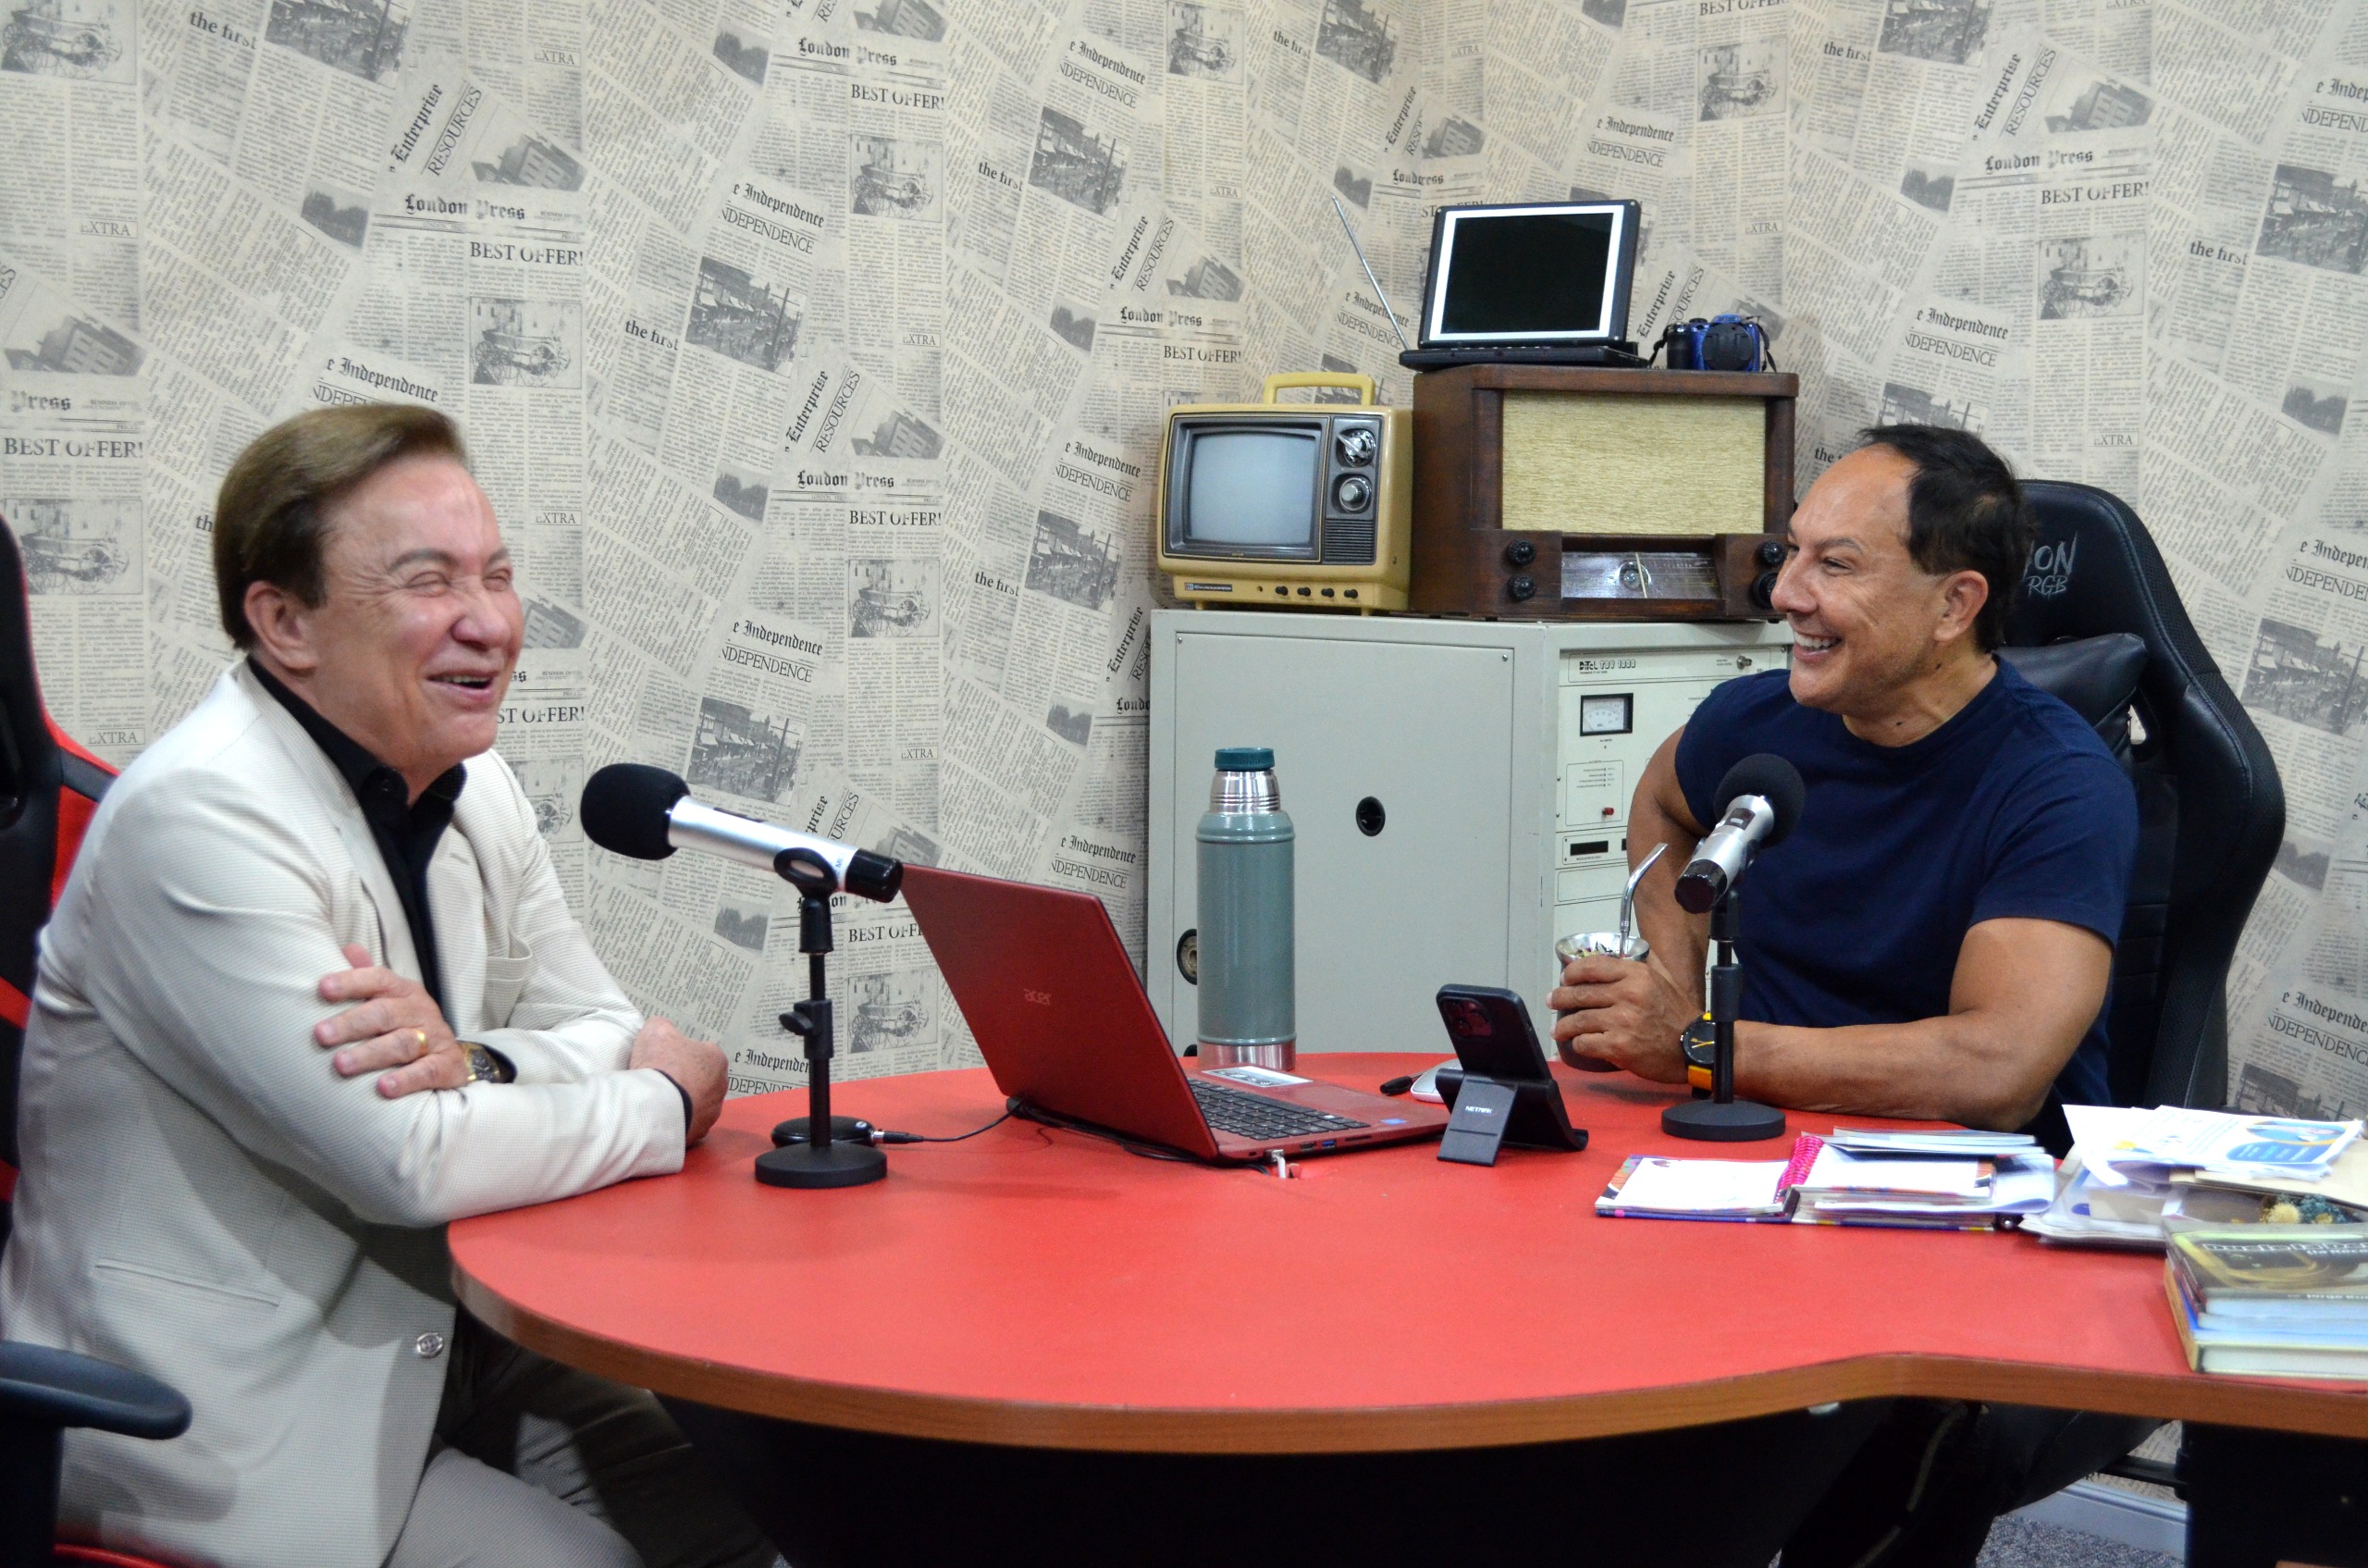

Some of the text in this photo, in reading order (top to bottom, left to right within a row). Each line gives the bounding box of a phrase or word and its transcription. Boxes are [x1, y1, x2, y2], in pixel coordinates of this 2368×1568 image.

[190, 11, 217, 33] the
[799, 37, 850, 59] London
[1273, 31, 1289, 48] the
[1824, 41, 1844, 56] the
[1078, 41, 1146, 85] Independence
[850, 83, 888, 103] BEST
[2005, 47, 2056, 137] RESOURCES
[428, 86, 482, 177] RESOURCES
[1606, 116, 1674, 142] Independence
[2300, 108, 2368, 133] NDEPEND
[979, 162, 997, 179] the
[1985, 154, 2041, 175] London
[405, 193, 468, 215] London
[744, 183, 824, 228] Independence
[2041, 187, 2083, 204] BEST
[470, 241, 516, 260] BEST
[1136, 216, 1175, 292] RESOURCES
[2189, 240, 2214, 258] the
[1671, 266, 1705, 324] OURCES
[1120, 306, 1164, 324] London
[1926, 307, 2009, 340] Independence
[625, 320, 648, 339] the
[1164, 345, 1194, 359] BEST
[339, 357, 438, 402] Independence
[816, 371, 860, 453] RESOURCES
[4, 437, 59, 456] BEST
[1074, 441, 1141, 478] Independence
[797, 470, 848, 489] London
[195, 514, 214, 532] th
[849, 511, 886, 525] BEST
[974, 572, 994, 588] the
[2027, 575, 2067, 599] RGB
[743, 620, 823, 656] Independence
[497, 709, 517, 723] ST
[1116, 697, 1150, 715] Londo
[830, 792, 859, 841] URCES
[1069, 834, 1136, 864] Independence
[849, 922, 923, 943] BEST OFF
[2293, 991, 2368, 1034] Independe
[2267, 1015, 2368, 1065] NDEPENDENC
